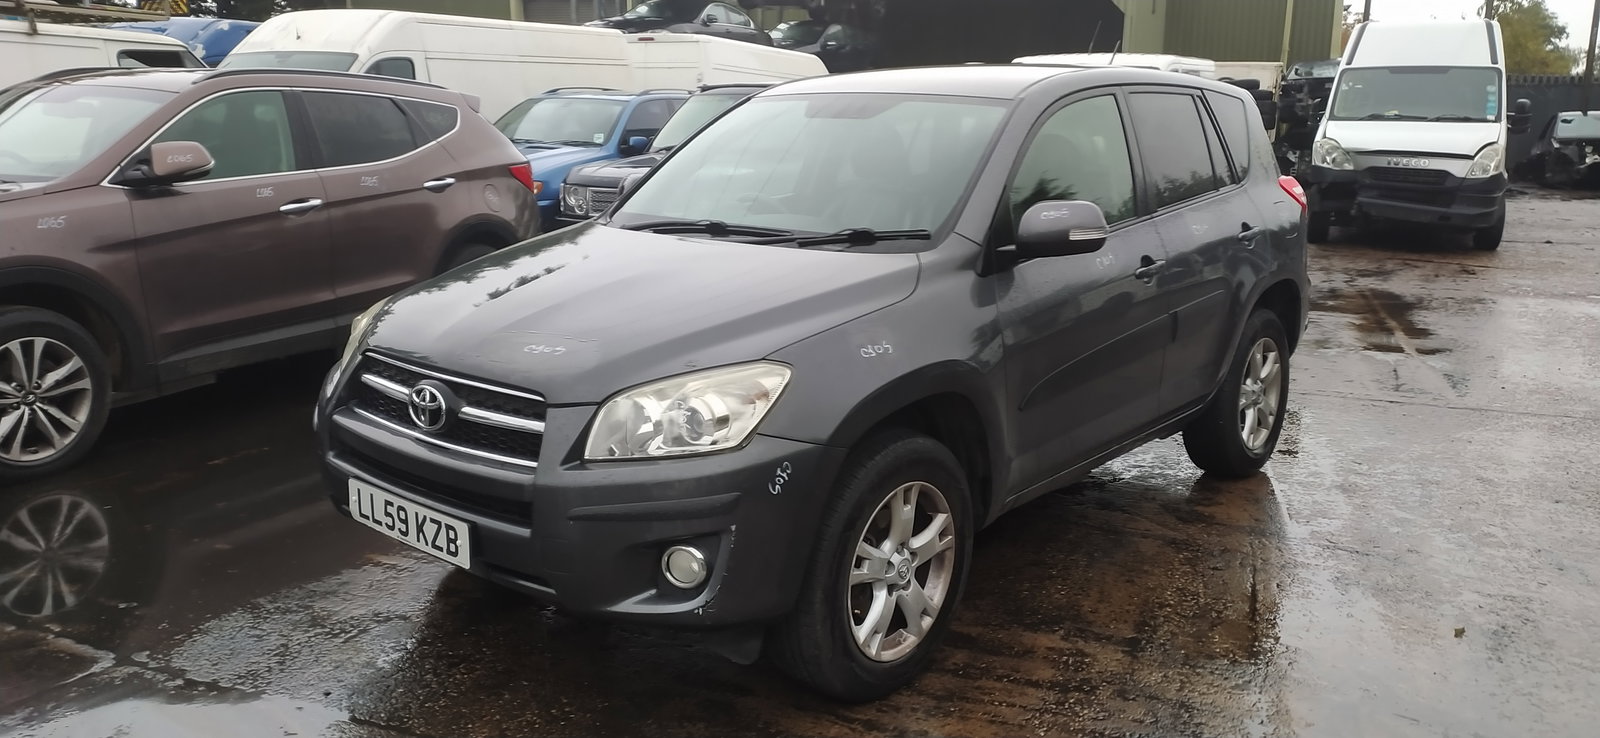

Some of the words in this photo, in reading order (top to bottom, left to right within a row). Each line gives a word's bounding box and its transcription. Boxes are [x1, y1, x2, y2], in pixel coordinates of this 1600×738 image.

[1387, 157, 1430, 168] IVECO
[357, 488, 409, 538] LL59
[414, 511, 459, 558] KZB
